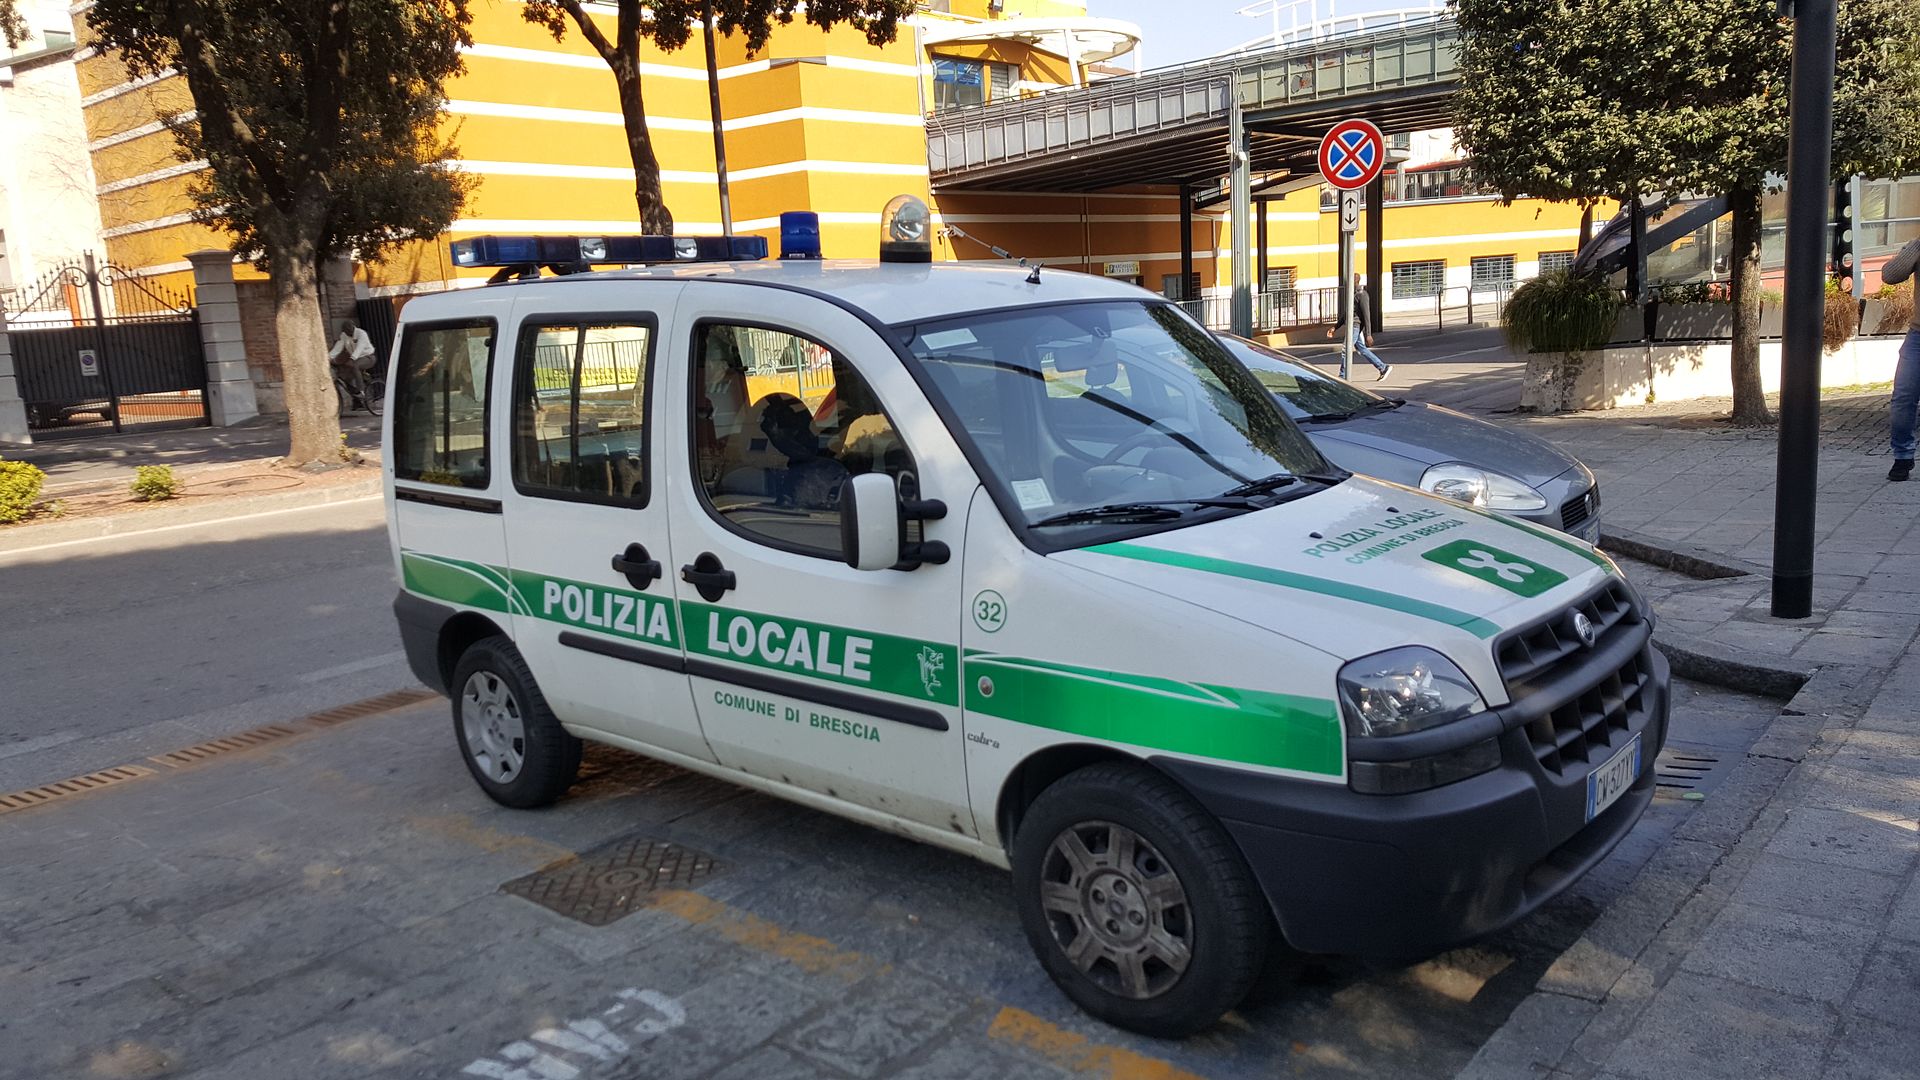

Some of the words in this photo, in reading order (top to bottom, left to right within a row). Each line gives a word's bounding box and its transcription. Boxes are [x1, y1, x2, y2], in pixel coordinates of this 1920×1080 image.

[1302, 527, 1385, 558] POLIZIA
[1374, 508, 1446, 530] LOCALE
[1345, 538, 1408, 565] COMUNE
[1404, 532, 1422, 542] DI
[1413, 518, 1468, 537] BRESCIA
[543, 580, 672, 642] POLIZIA
[707, 611, 874, 682] LOCALE
[978, 600, 1001, 623] 32
[714, 690, 776, 718] COMUNE
[785, 707, 800, 723] DI
[809, 712, 881, 742] BRESCIA
